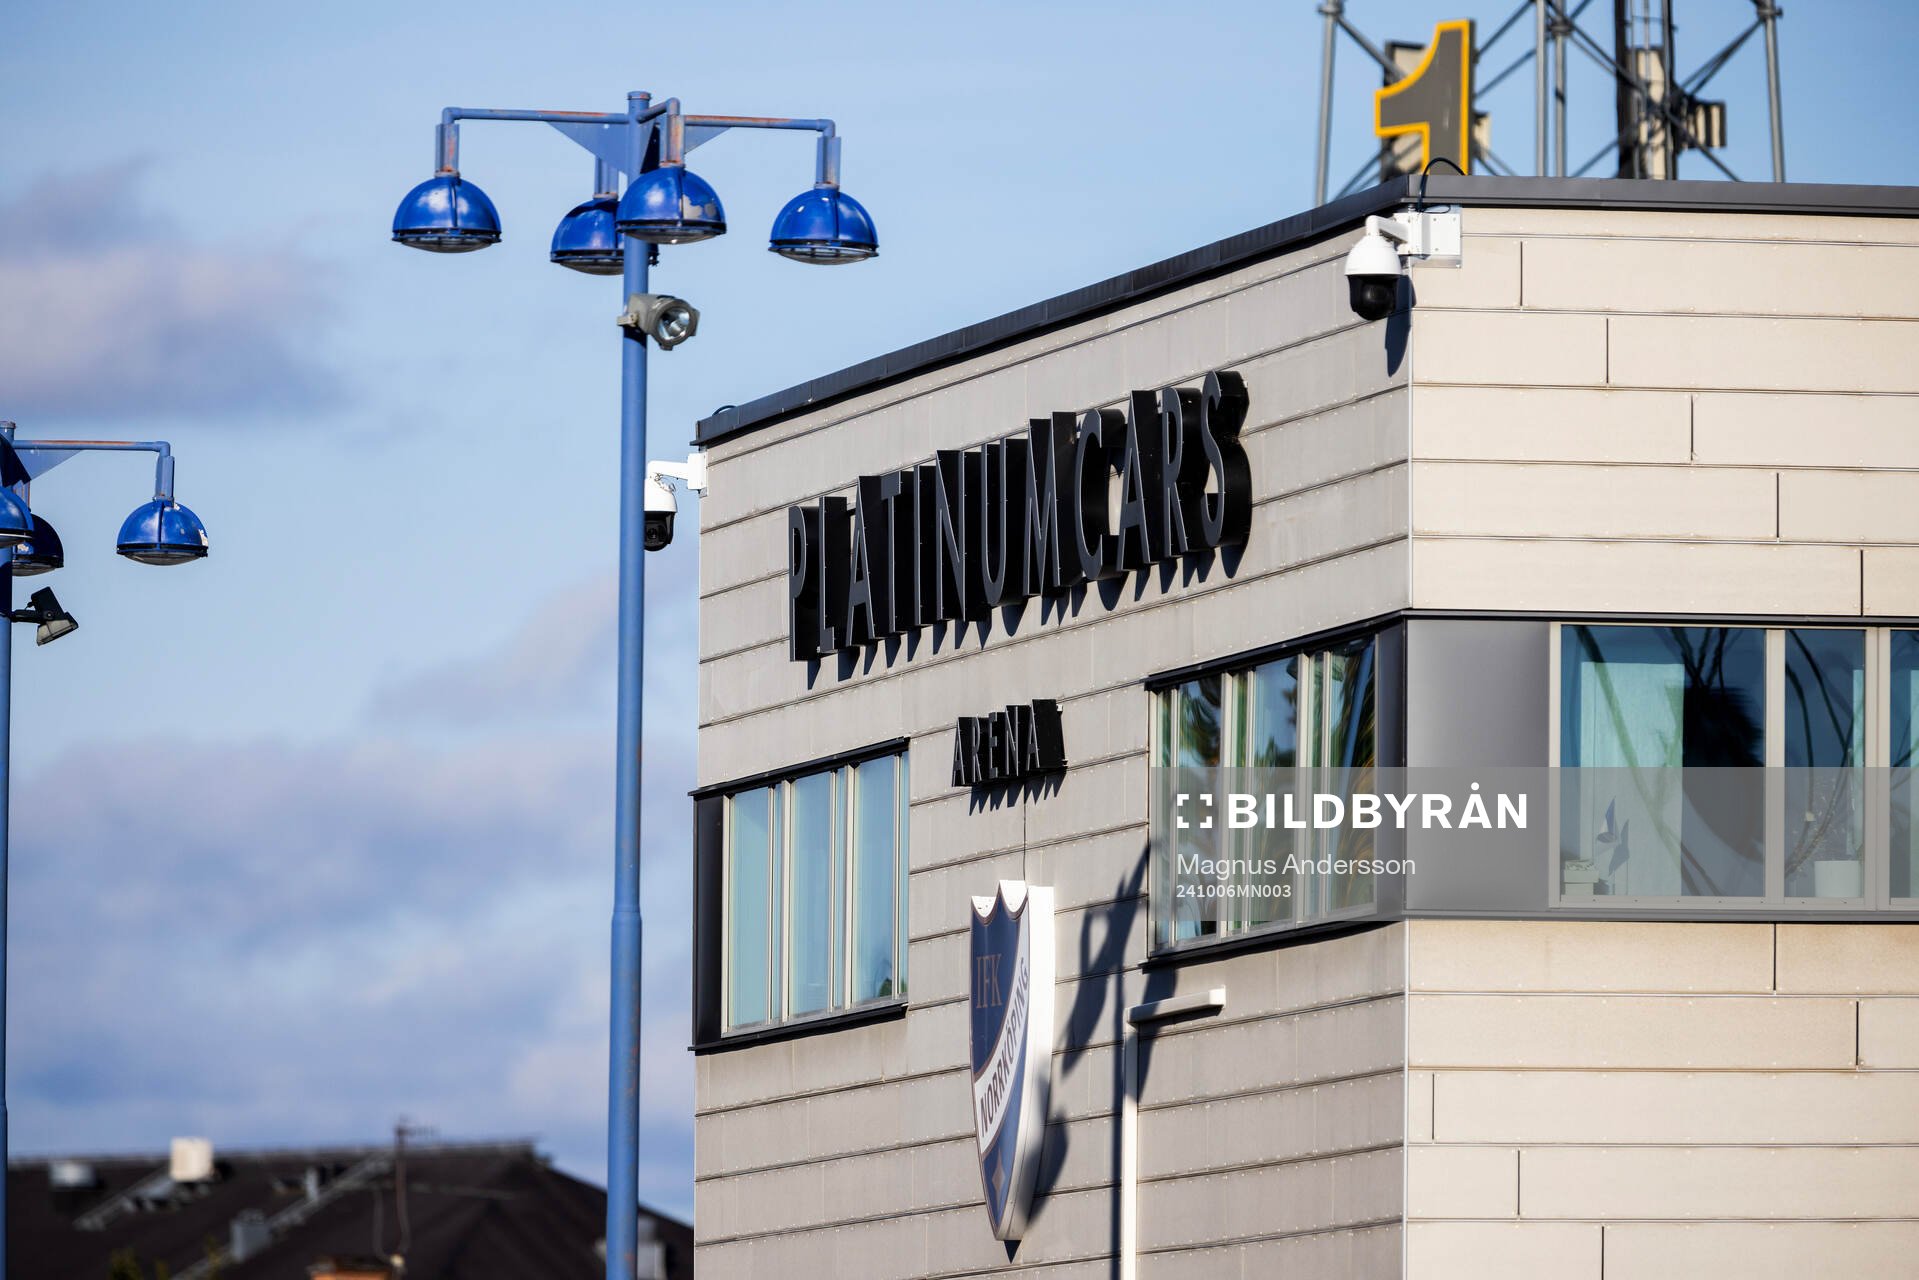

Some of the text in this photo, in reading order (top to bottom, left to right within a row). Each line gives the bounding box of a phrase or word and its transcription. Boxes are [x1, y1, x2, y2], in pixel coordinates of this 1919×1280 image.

[1374, 19, 1475, 175] 1
[788, 370, 1252, 661] PLATINUMCARS
[952, 698, 1062, 786] ARENA
[976, 954, 1002, 1008] IFK
[980, 957, 1029, 1137] NORRKÖPING
